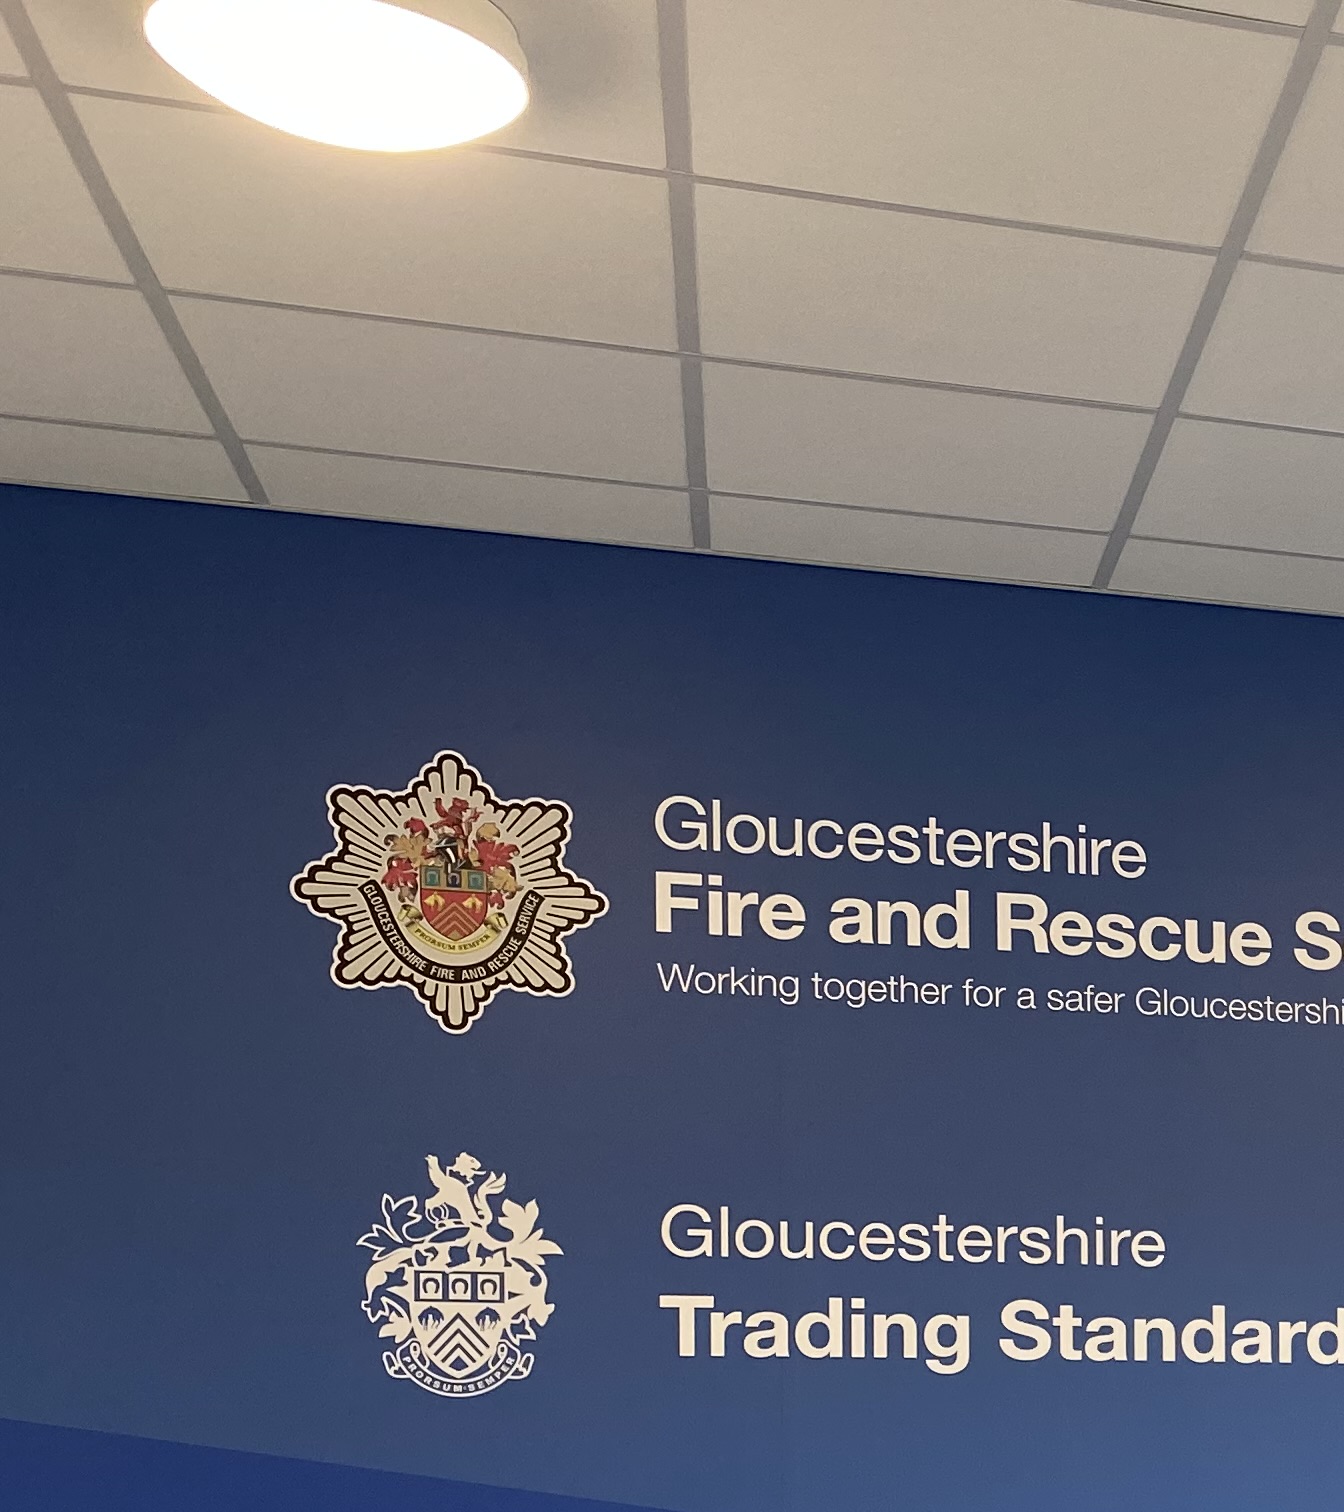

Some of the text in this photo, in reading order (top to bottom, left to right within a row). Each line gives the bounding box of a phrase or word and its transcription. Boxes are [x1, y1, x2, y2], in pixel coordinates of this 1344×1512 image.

[654, 795, 1147, 879] Gloucestershire
[362, 883, 540, 981] GLOUCESTERSHIRE FIRE AND RESCUE SERVICE
[655, 870, 806, 941] Fire
[829, 889, 971, 949] and
[996, 891, 1273, 966] Rescue
[656, 962, 800, 1006] Working
[811, 972, 953, 1009] together
[961, 978, 1007, 1008] for
[1016, 987, 1037, 1010] a
[1046, 984, 1125, 1014] safer
[660, 1203, 1167, 1268] Gloucestershire
[659, 1294, 970, 1375] Trading
